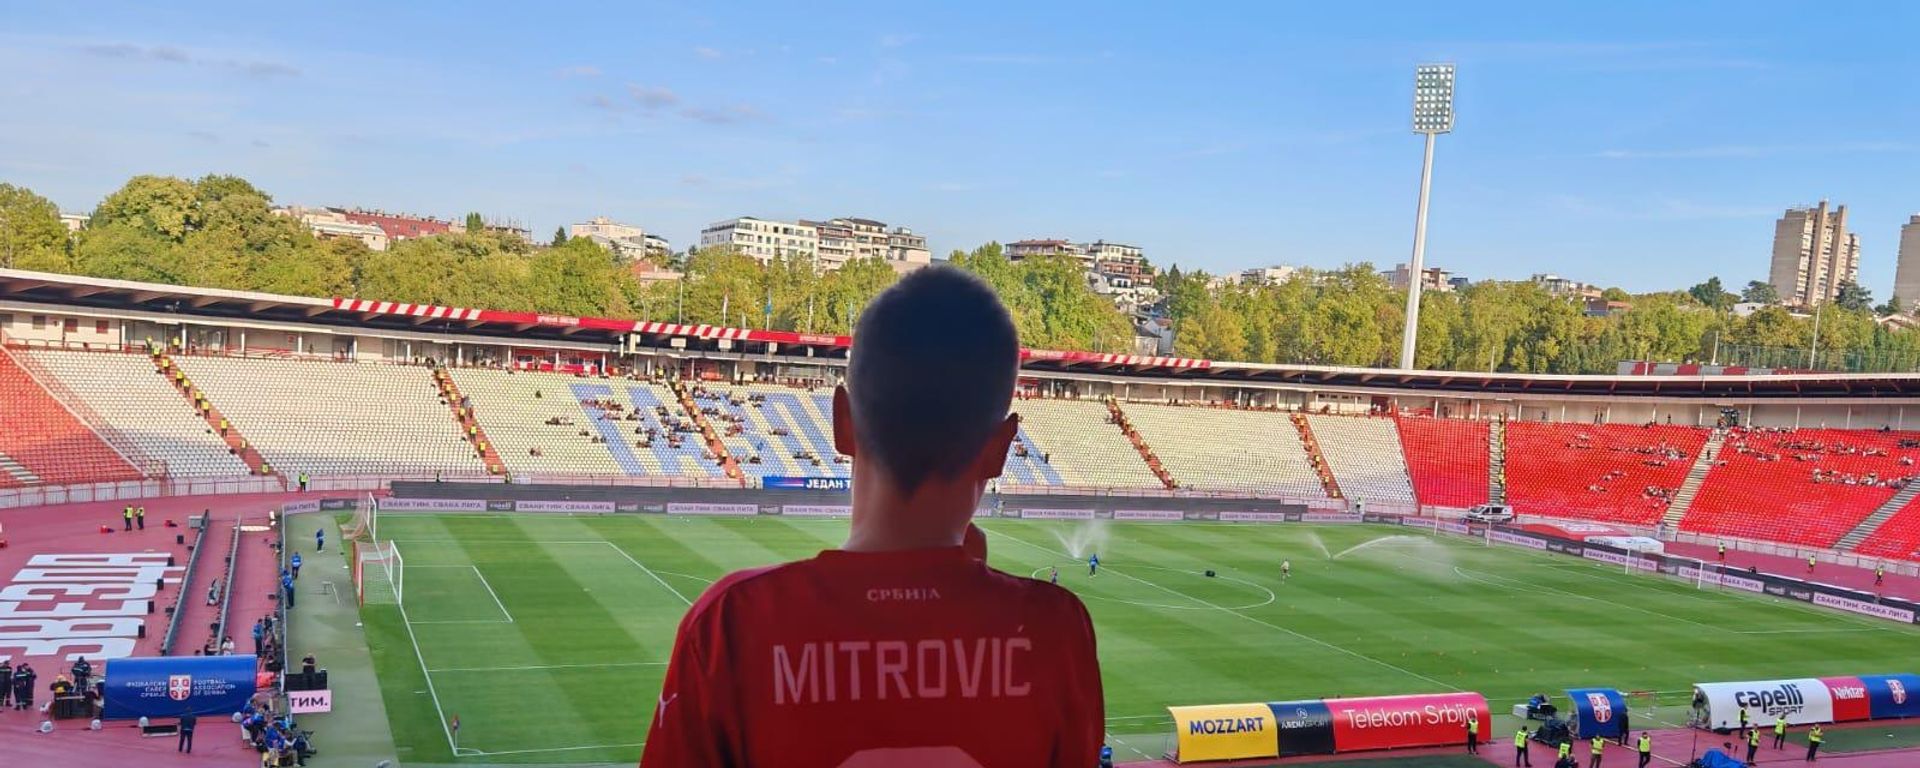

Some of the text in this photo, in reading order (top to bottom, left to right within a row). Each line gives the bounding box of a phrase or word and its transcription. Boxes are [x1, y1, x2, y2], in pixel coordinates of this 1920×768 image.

[806, 479, 844, 489] ЈЕДАН
[867, 588, 940, 601] СРБИЈА
[1816, 596, 1840, 605] СВАКИ
[1861, 604, 1886, 614] СВАКА
[773, 625, 1032, 704] MITROVIĆ
[1735, 683, 1804, 713] capelli
[1832, 686, 1864, 699] Nektar
[1344, 704, 1478, 729] Telekom Srbija
[1769, 706, 1804, 716] SPORT
[1190, 717, 1264, 735] MOZZART
